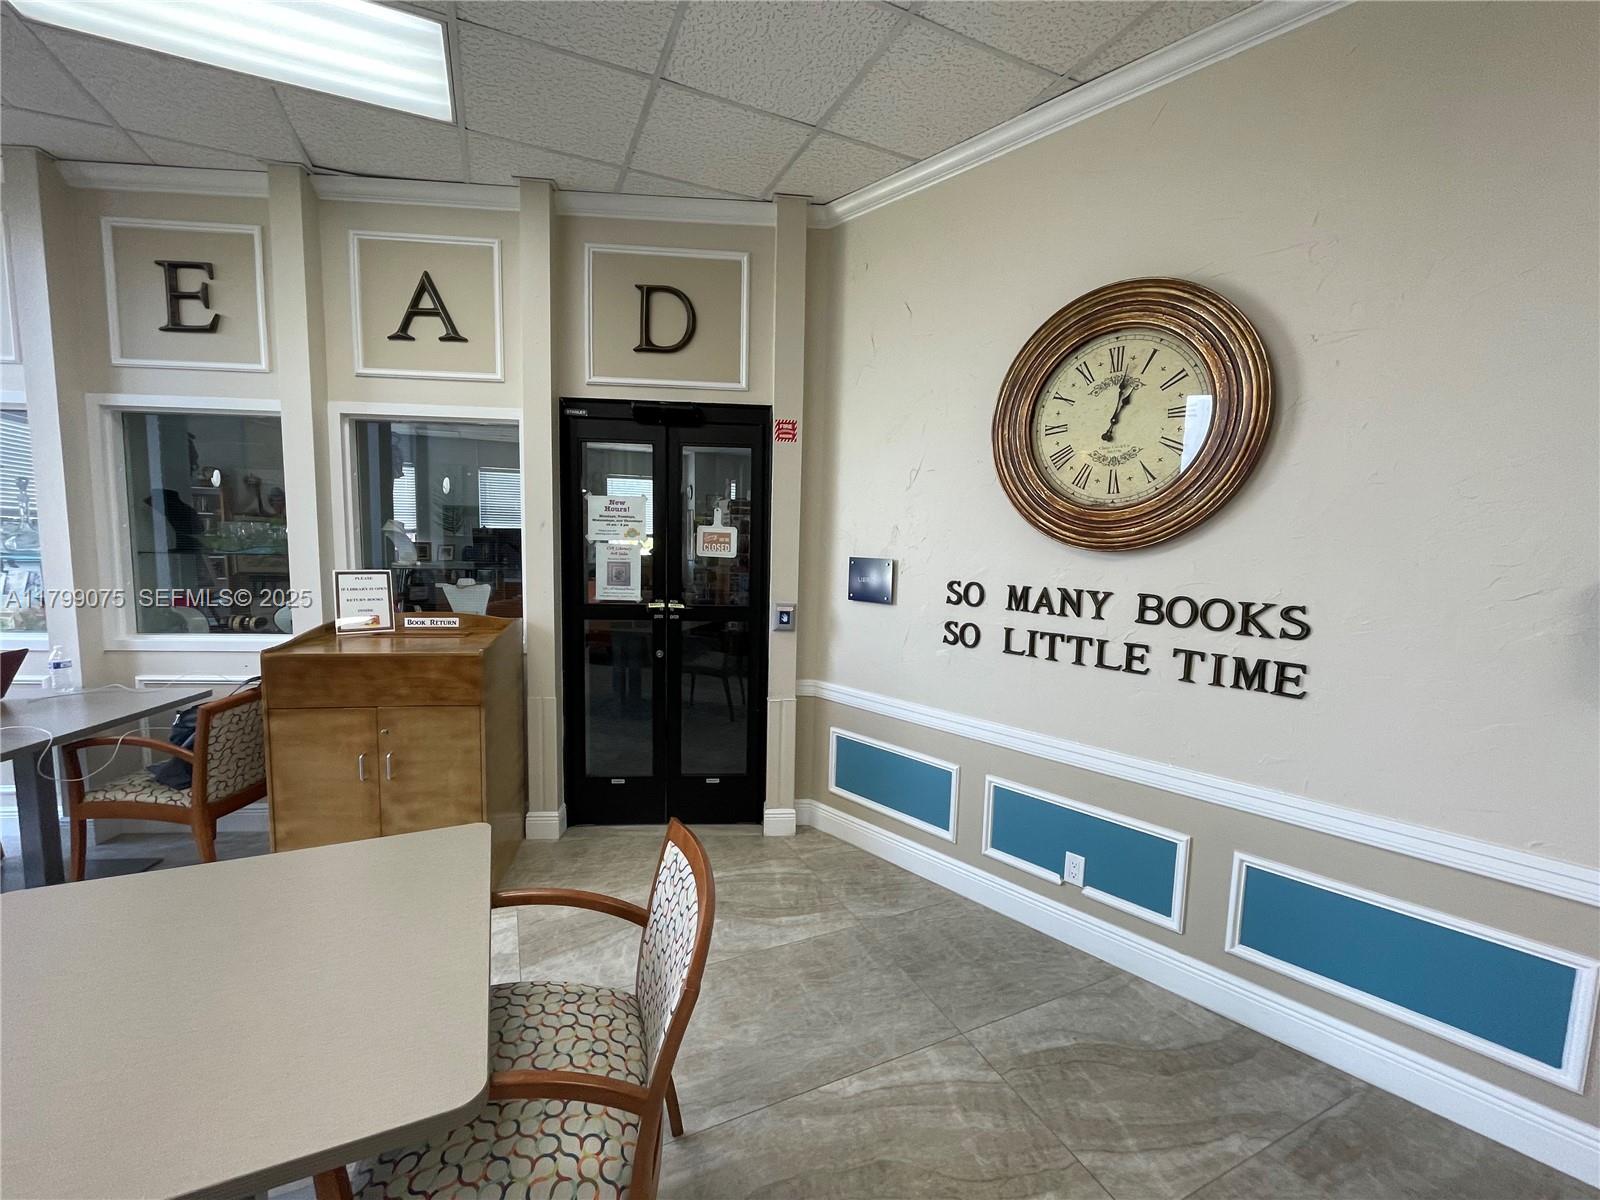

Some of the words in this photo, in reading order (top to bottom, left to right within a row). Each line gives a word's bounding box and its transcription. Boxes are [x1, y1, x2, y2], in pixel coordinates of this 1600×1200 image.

[154, 259, 222, 333] E
[387, 269, 469, 343] A
[633, 283, 697, 354] D
[1109, 346, 1125, 373] XII
[703, 543, 730, 551] CLOSED
[945, 580, 985, 608] SO
[1005, 584, 1115, 621] MANY
[1134, 593, 1312, 641] BOOKS
[943, 621, 981, 649] SO
[1003, 627, 1151, 675] LITTLE
[1173, 648, 1308, 700] TIME
